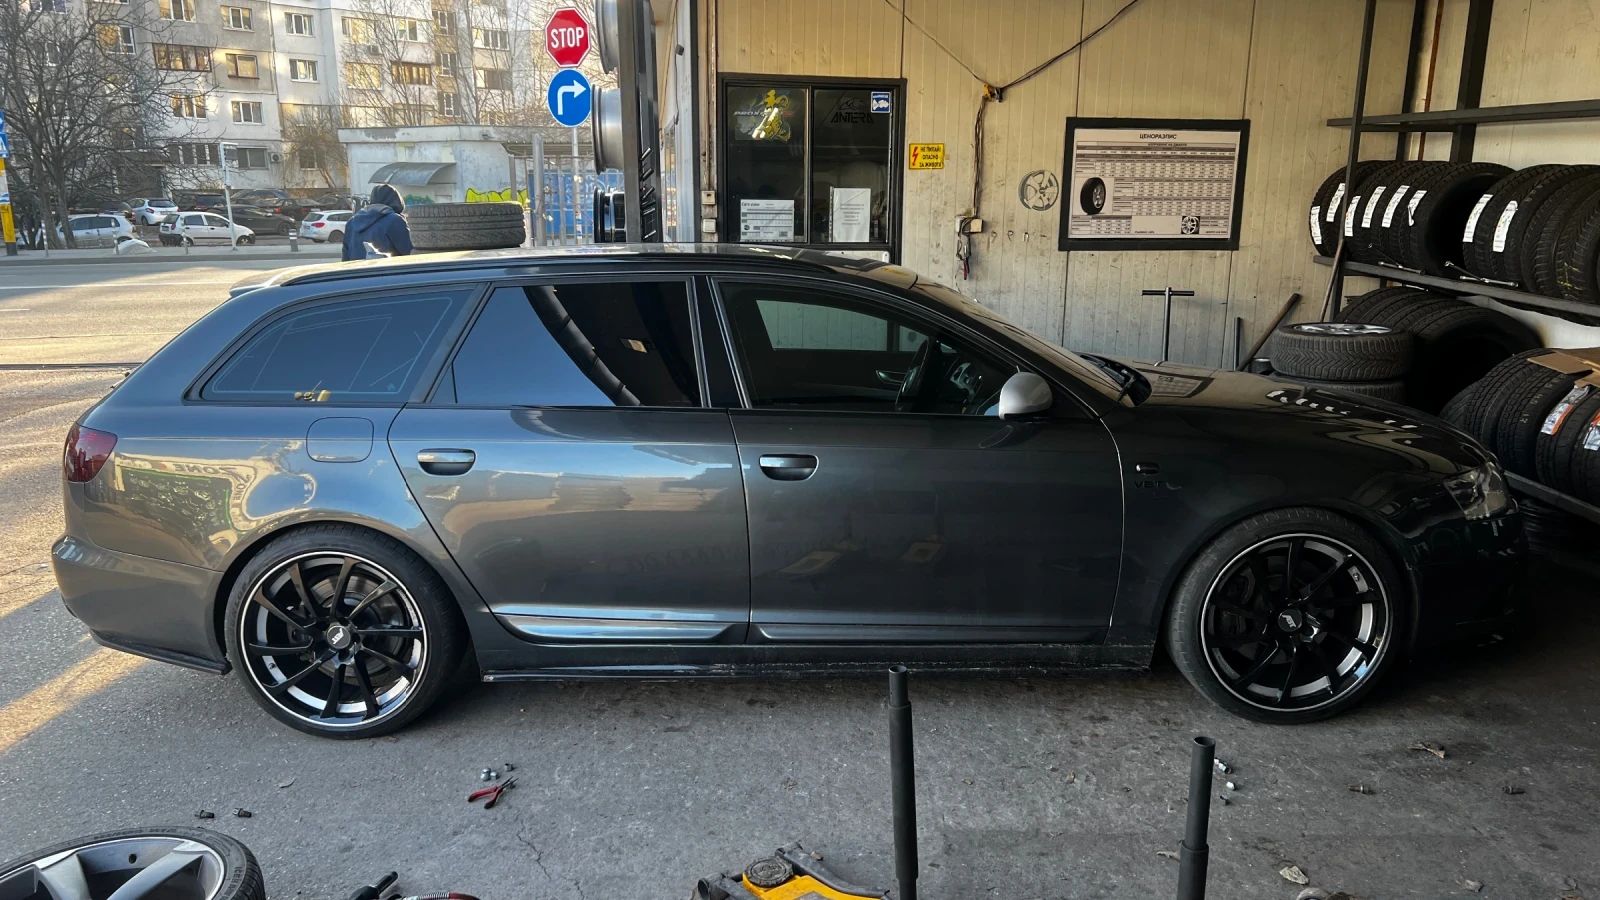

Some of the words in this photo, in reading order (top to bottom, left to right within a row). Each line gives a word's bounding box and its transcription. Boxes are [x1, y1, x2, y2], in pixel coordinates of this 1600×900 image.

[551, 26, 584, 48] STOP
[830, 111, 874, 124] ANTERA
[1281, 614, 1297, 628] ABT
[331, 627, 344, 645] ABT
